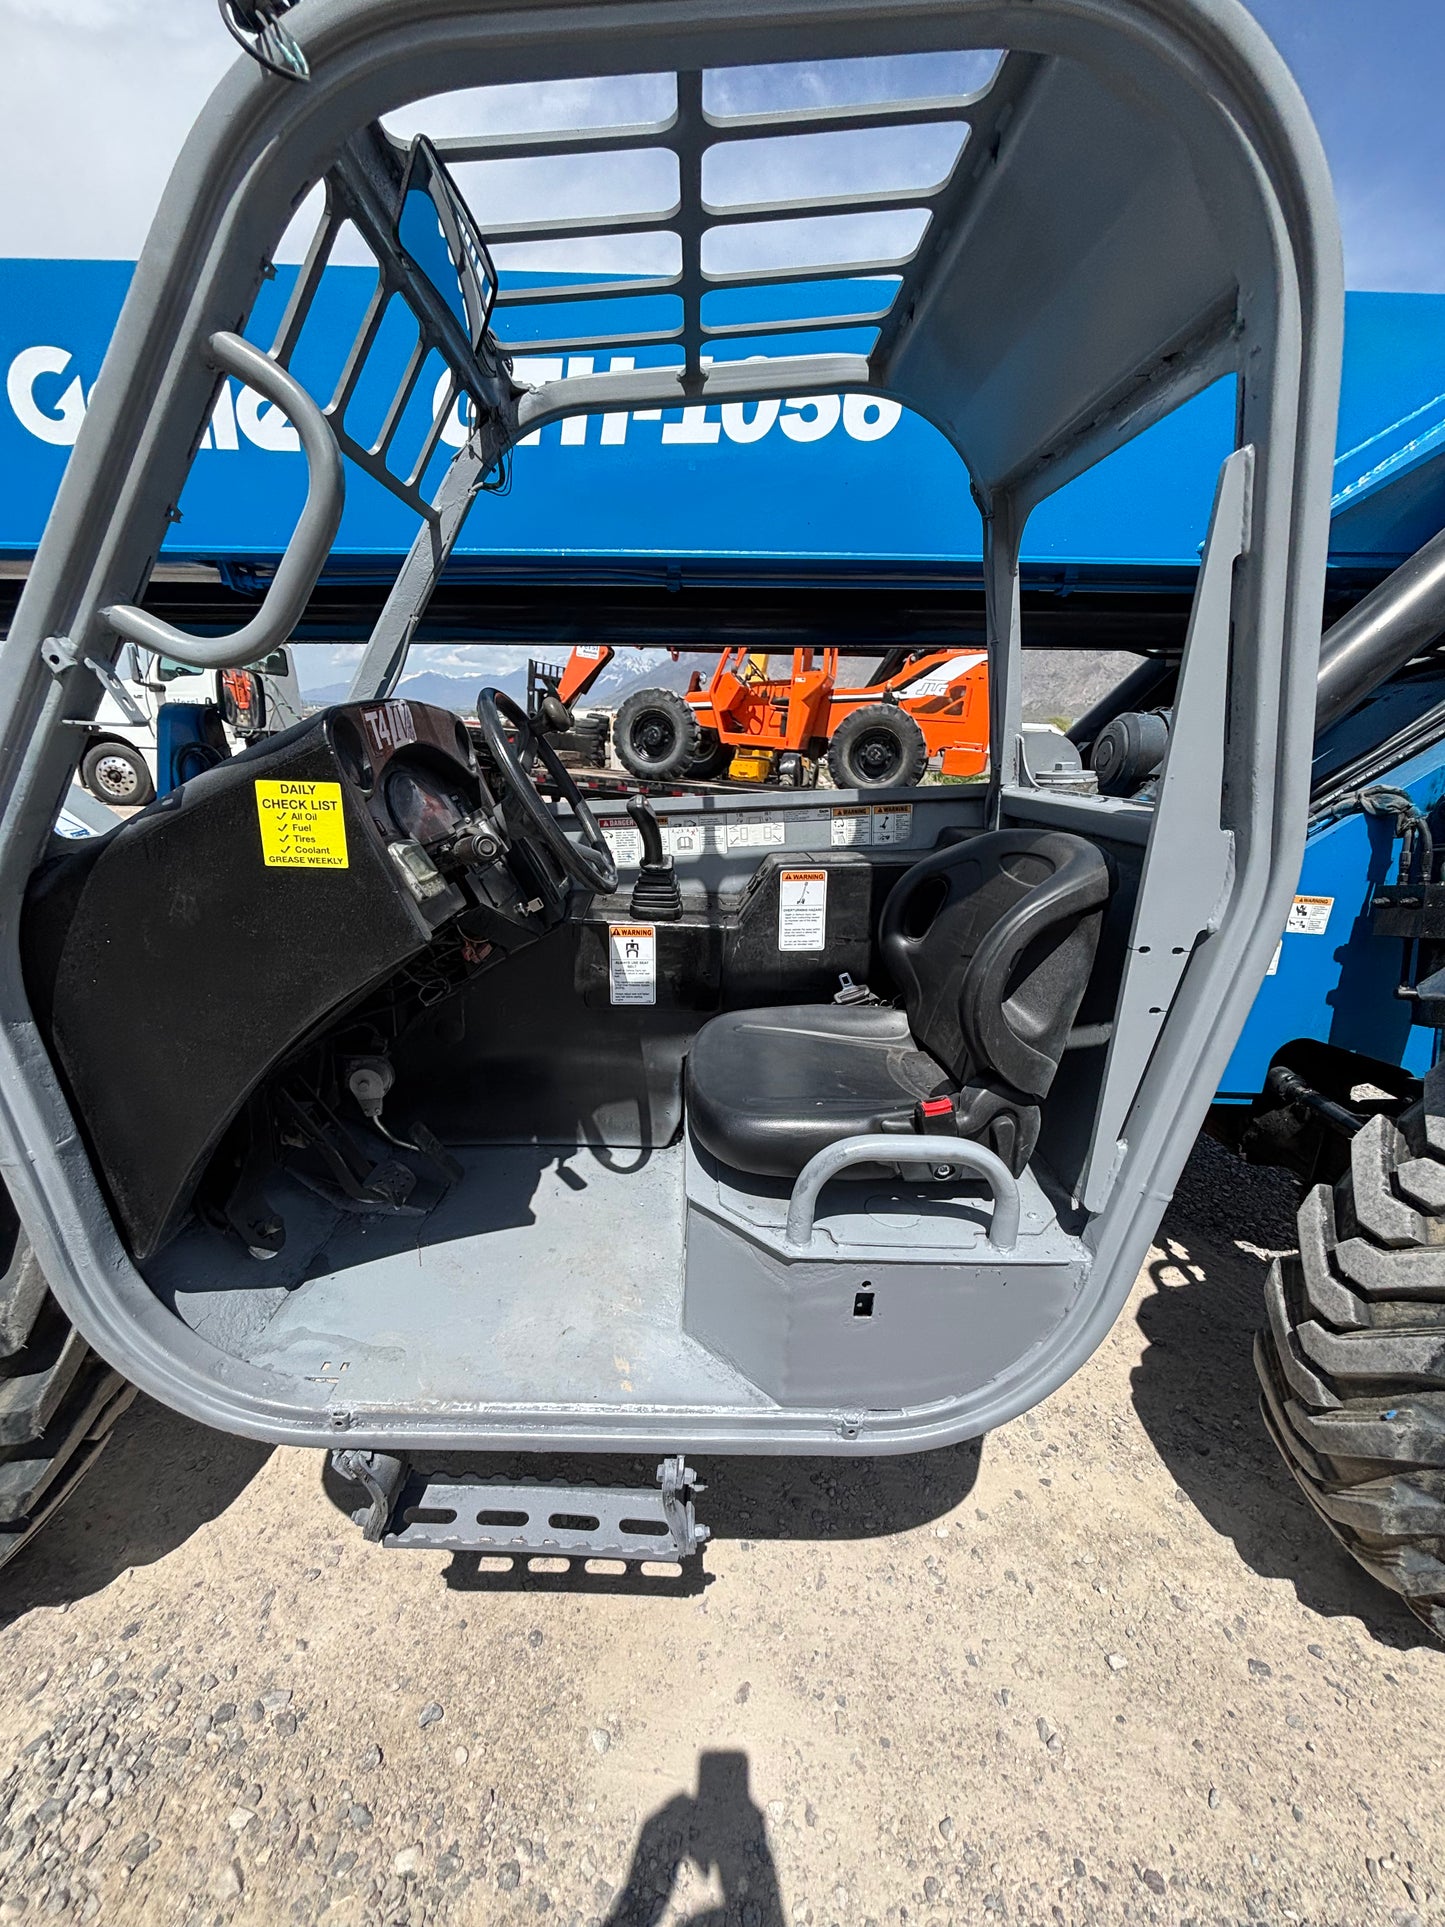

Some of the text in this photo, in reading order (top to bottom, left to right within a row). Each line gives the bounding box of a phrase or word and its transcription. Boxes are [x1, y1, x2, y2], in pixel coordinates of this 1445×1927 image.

[915, 682, 949, 696] JLG
[280, 784, 316, 795] DAILY
[262, 798, 338, 811] CHECK LIST
[291, 812, 318, 821] All Oil
[292, 824, 312, 832] Fuel
[609, 819, 635, 828] DANGER
[293, 834, 316, 843] Tires
[295, 845, 331, 854] Coolant
[268, 855, 343, 865] GREASE WEEKLY
